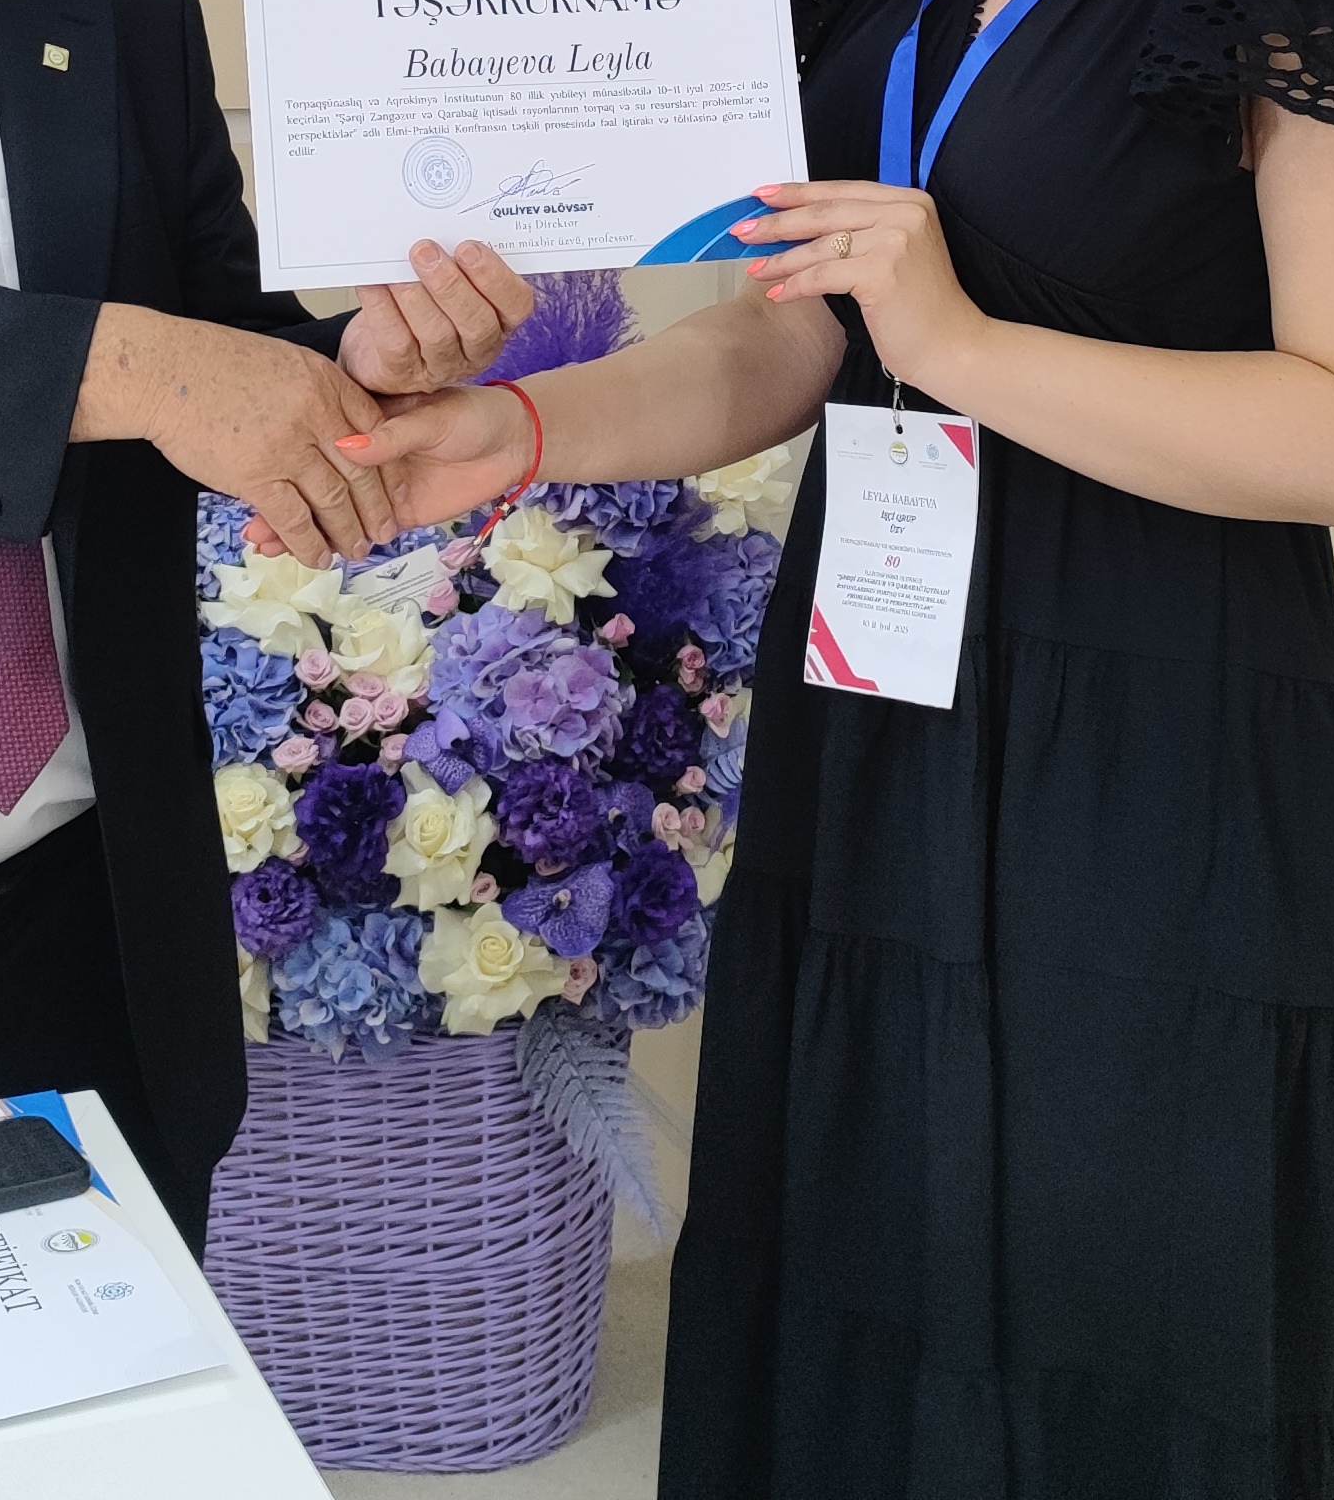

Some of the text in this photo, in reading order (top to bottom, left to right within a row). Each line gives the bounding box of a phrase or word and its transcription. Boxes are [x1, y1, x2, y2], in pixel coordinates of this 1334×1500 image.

[402, 42, 653, 84] Babayeva Leyla
[510, 91, 522, 100] 80
[528, 90, 545, 100] illik
[550, 88, 587, 101] yubileyi
[686, 83, 704, 96] iyul
[709, 81, 745, 92] 2025-ci
[438, 107, 479, 120] Qarabağ
[482, 106, 518, 119] iqtisadi
[493, 202, 595, 218] QULİYEV ƏLÖVSƏT
[515, 218, 579, 234] Baş Direktor
[587, 231, 637, 245] professor.
[863, 489, 937, 509] LEYLA BABAYEVA
[885, 555, 900, 568] 80
